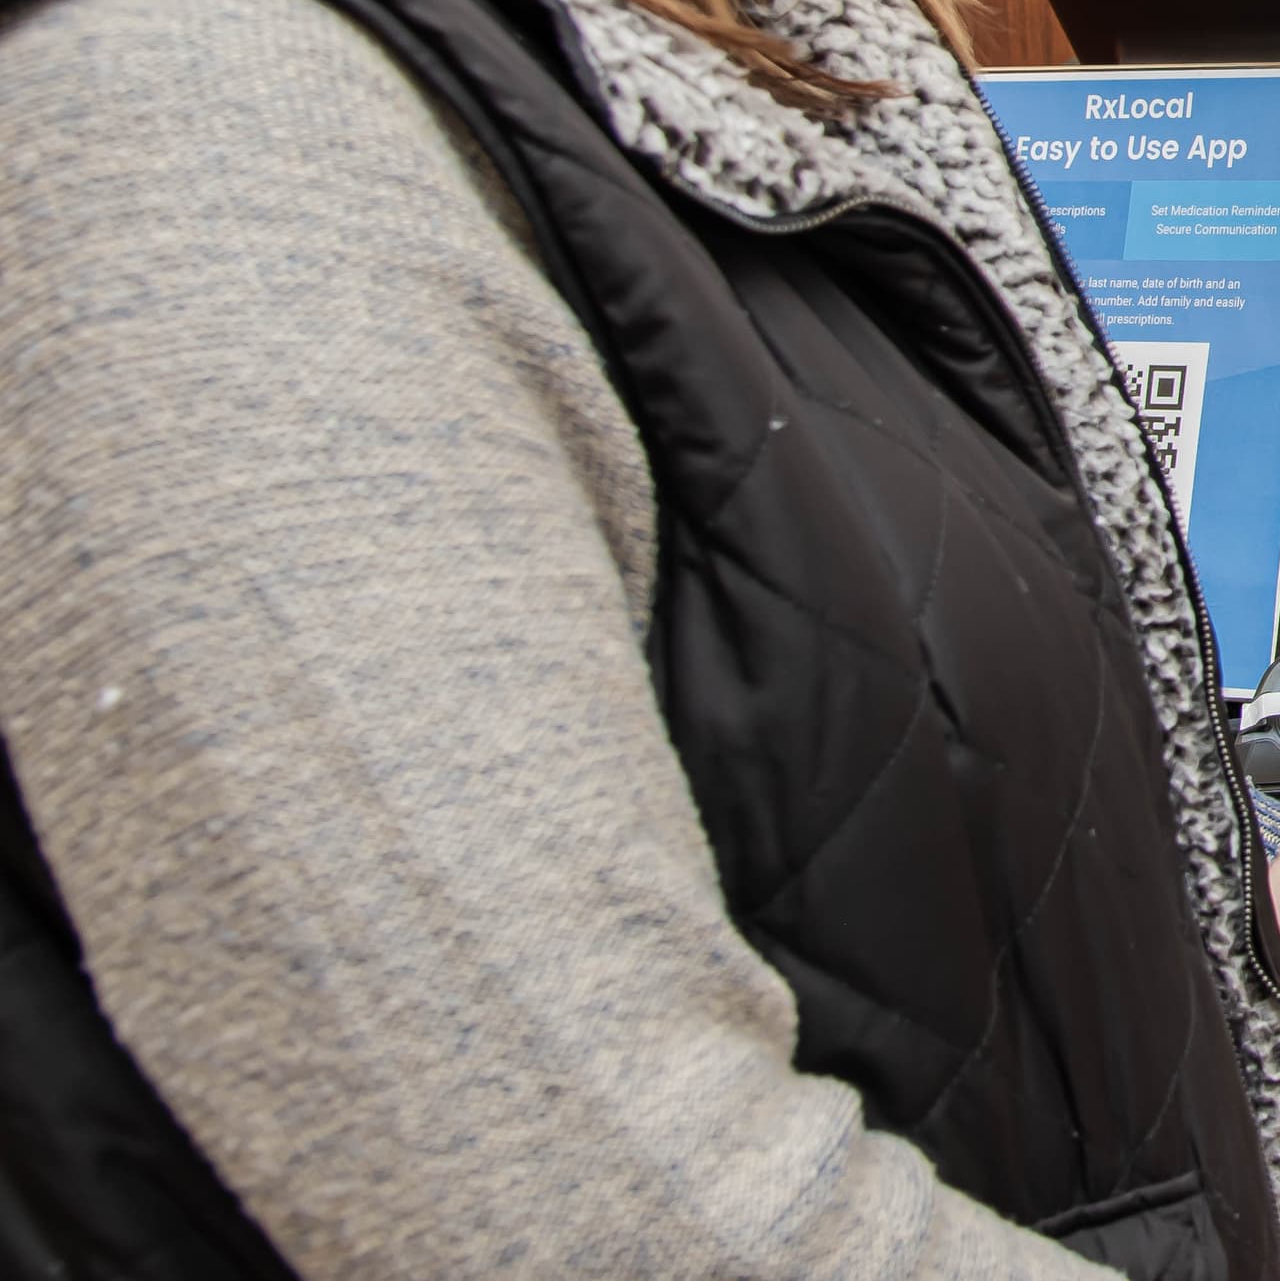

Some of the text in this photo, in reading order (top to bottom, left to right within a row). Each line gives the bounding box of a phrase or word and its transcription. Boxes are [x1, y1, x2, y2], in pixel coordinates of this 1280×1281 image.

[1085, 92, 1194, 120] RxLocal
[1016, 134, 1248, 169] Easy to Use App
[1151, 205, 1168, 217] Set
[1170, 205, 1229, 217] Medication
[1156, 223, 1278, 236] Secure Communication
[1089, 277, 1107, 289] last
[1109, 279, 1140, 290] name,
[1142, 278, 1164, 289] date
[1167, 277, 1178, 289] of
[1179, 277, 1204, 289] birth
[1205, 278, 1226, 290] and
[1227, 280, 1241, 290] an
[1094, 296, 1135, 308] number.
[1137, 296, 1158, 307] Add
[1160, 296, 1192, 310] family
[1193, 296, 1214, 308] and
[1215, 297, 1246, 311] easily
[1106, 315, 1176, 328] prescriptions.
